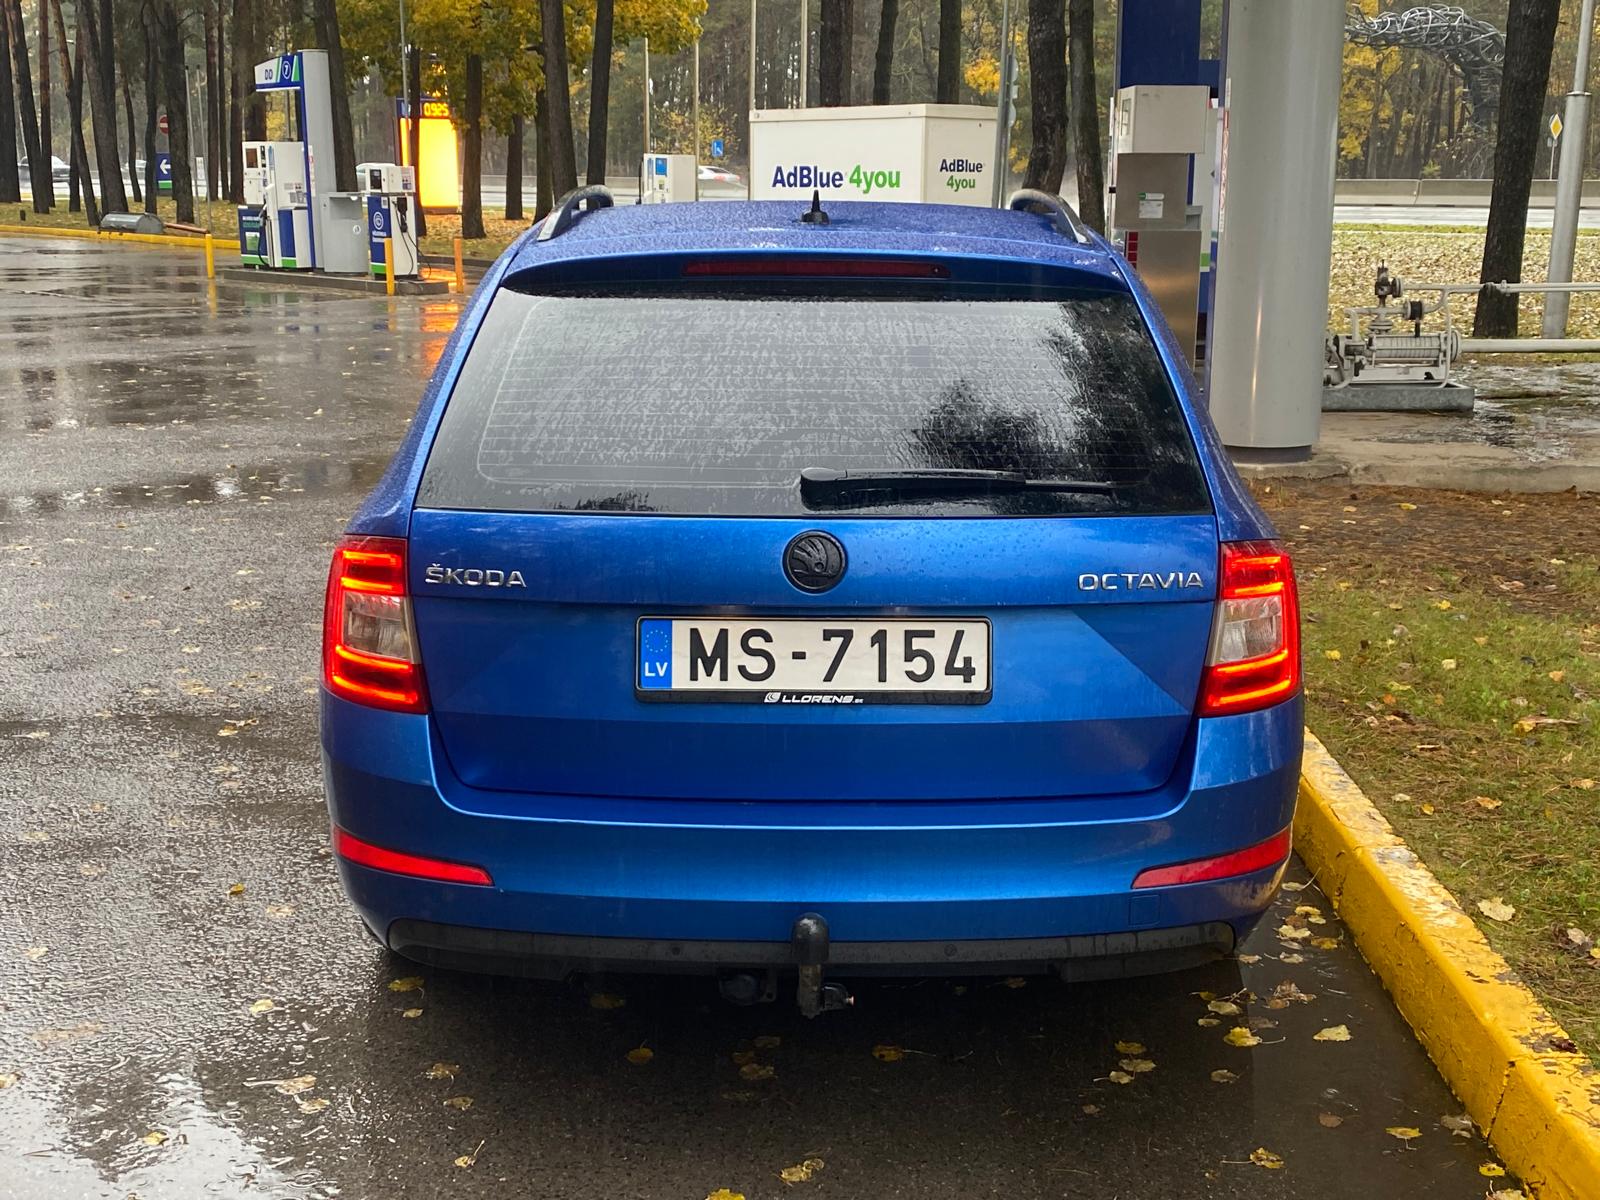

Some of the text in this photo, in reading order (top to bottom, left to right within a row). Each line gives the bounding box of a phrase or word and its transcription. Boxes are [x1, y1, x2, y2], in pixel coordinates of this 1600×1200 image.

[284, 64, 289, 75] 7
[939, 158, 983, 173] AdBlue
[772, 164, 901, 194] AdBlue 4you
[946, 174, 976, 192] 4you
[425, 562, 527, 588] ŠKODA
[1078, 571, 1204, 590] OCTAVIA
[689, 628, 977, 683] MS-7154
[644, 662, 668, 677] LV
